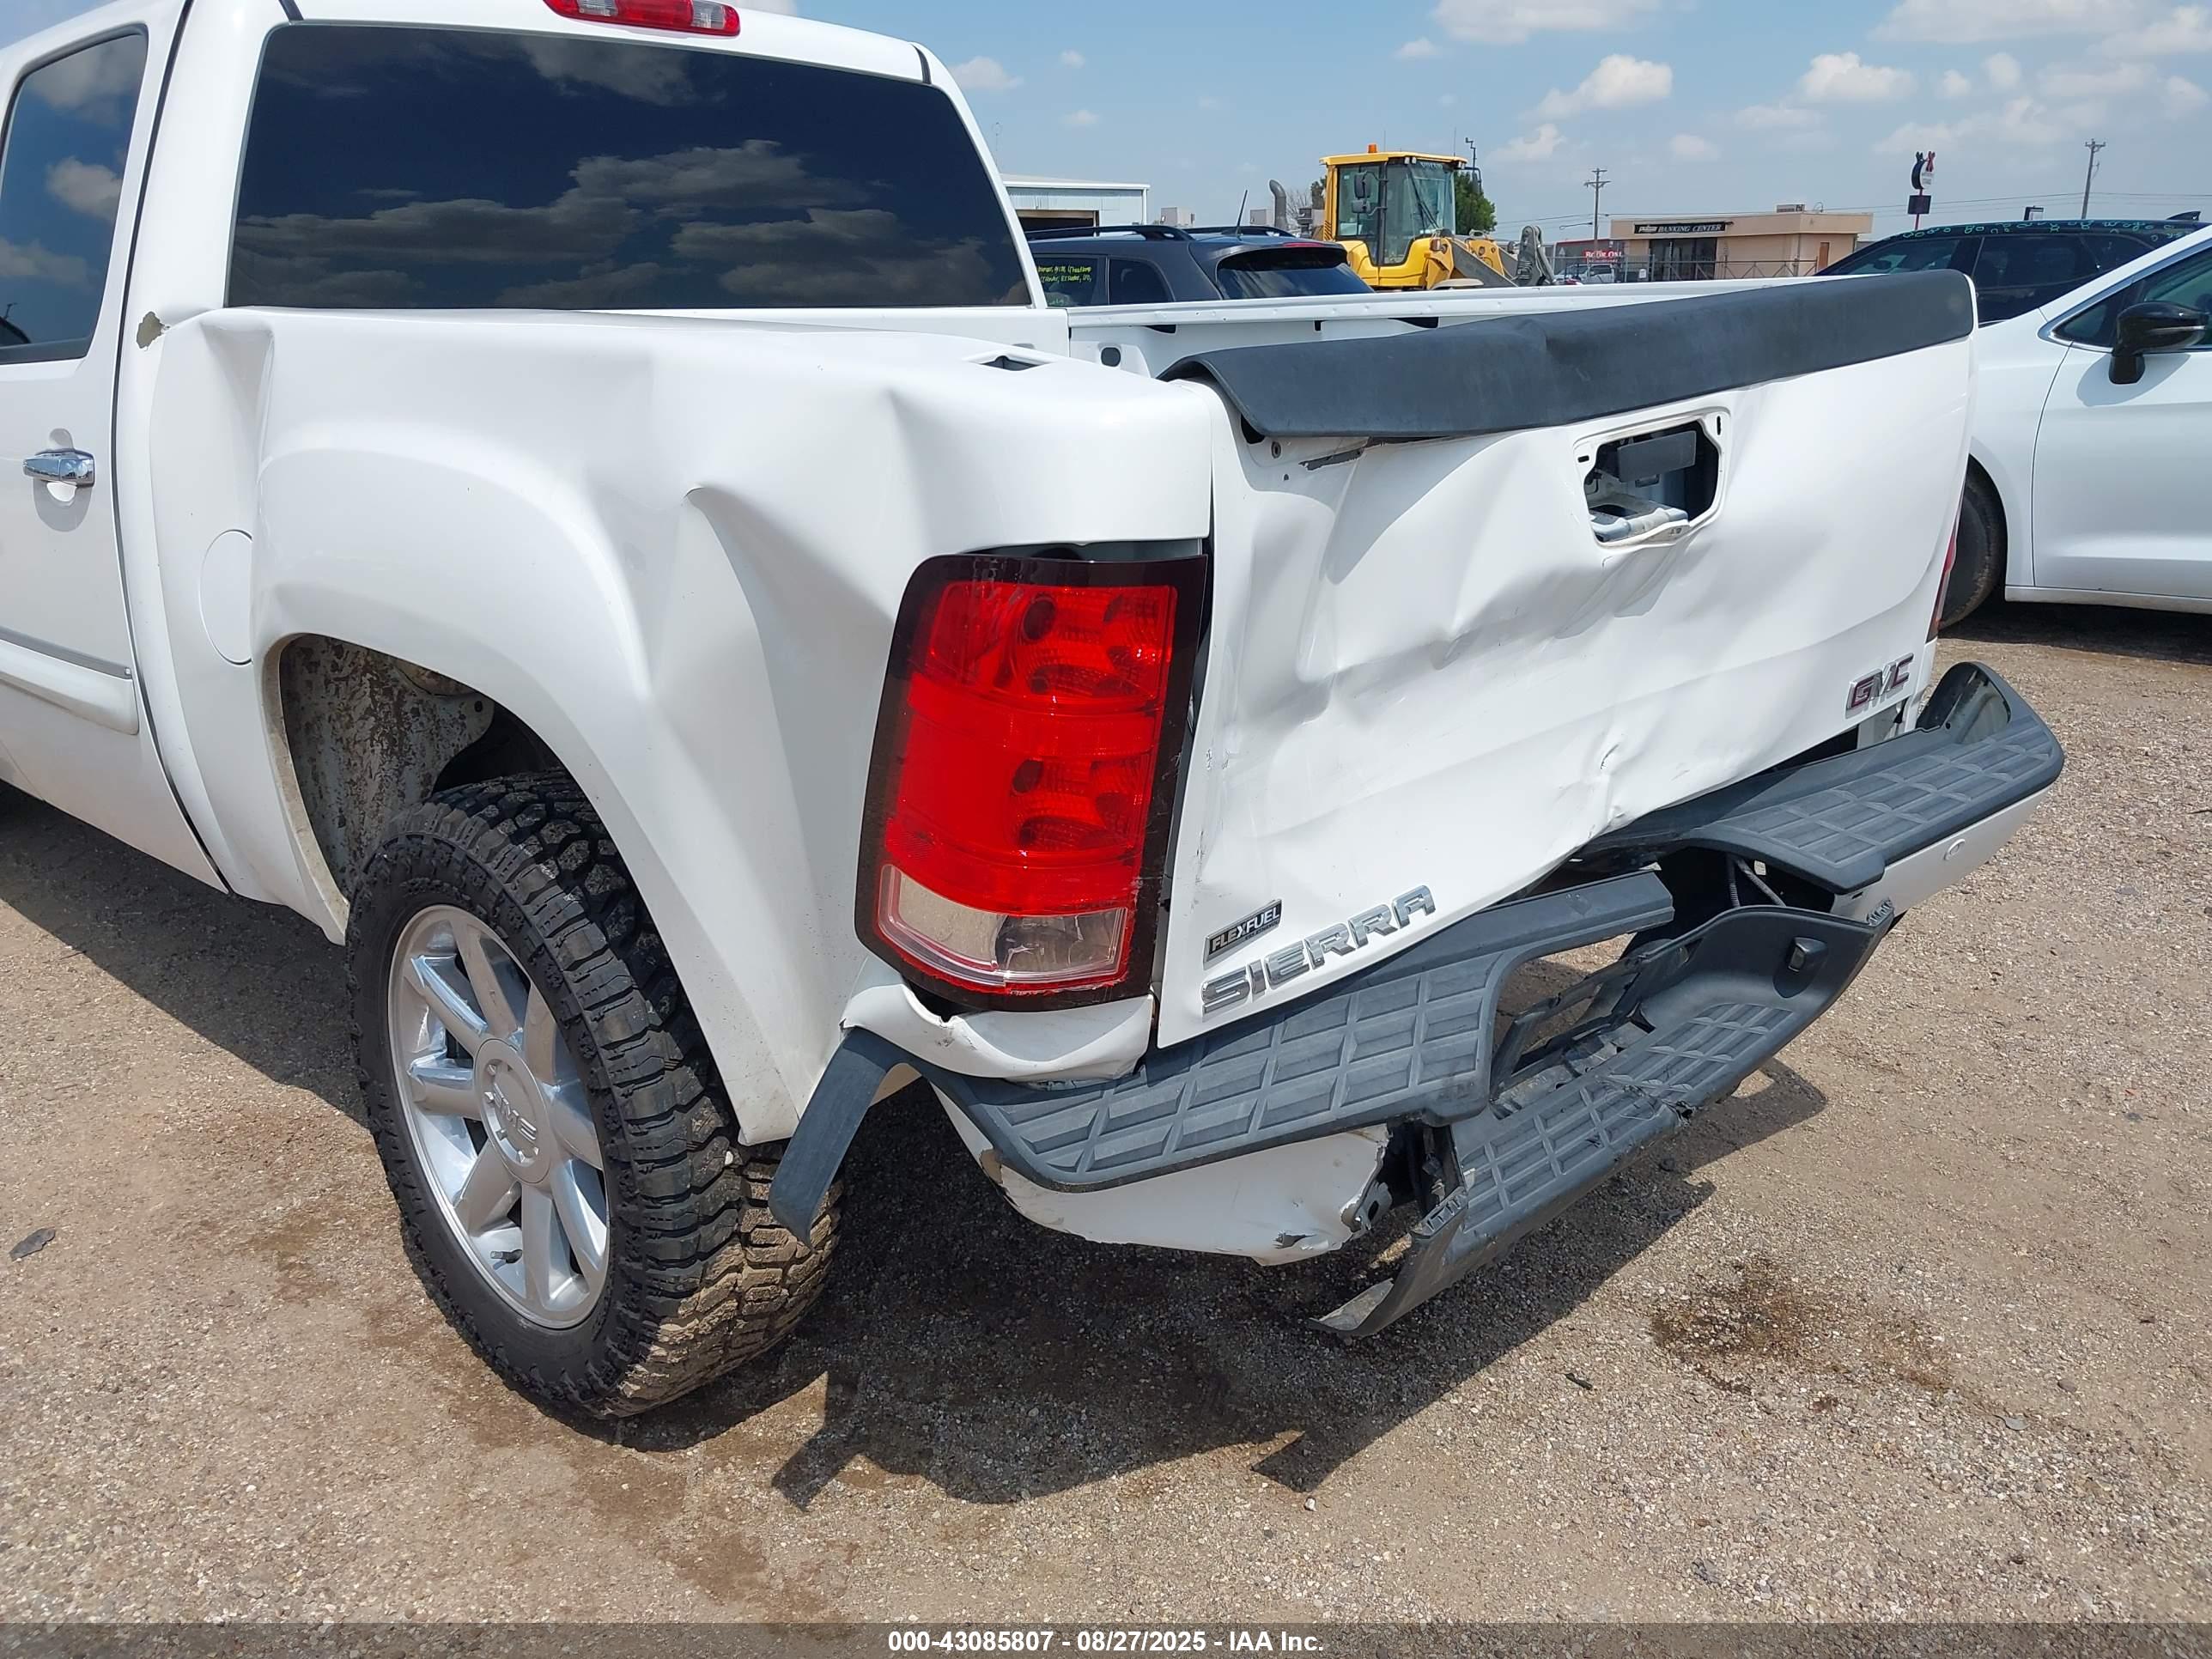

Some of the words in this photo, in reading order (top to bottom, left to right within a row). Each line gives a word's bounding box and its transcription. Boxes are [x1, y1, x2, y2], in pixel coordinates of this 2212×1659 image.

[1657, 225, 1691, 234] BANKING
[1692, 223, 1722, 233] CENTER
[1846, 652, 1914, 709] GMC
[1200, 884, 1437, 1016] SIERRA
[1211, 907, 1280, 953] FLEXFUEL
